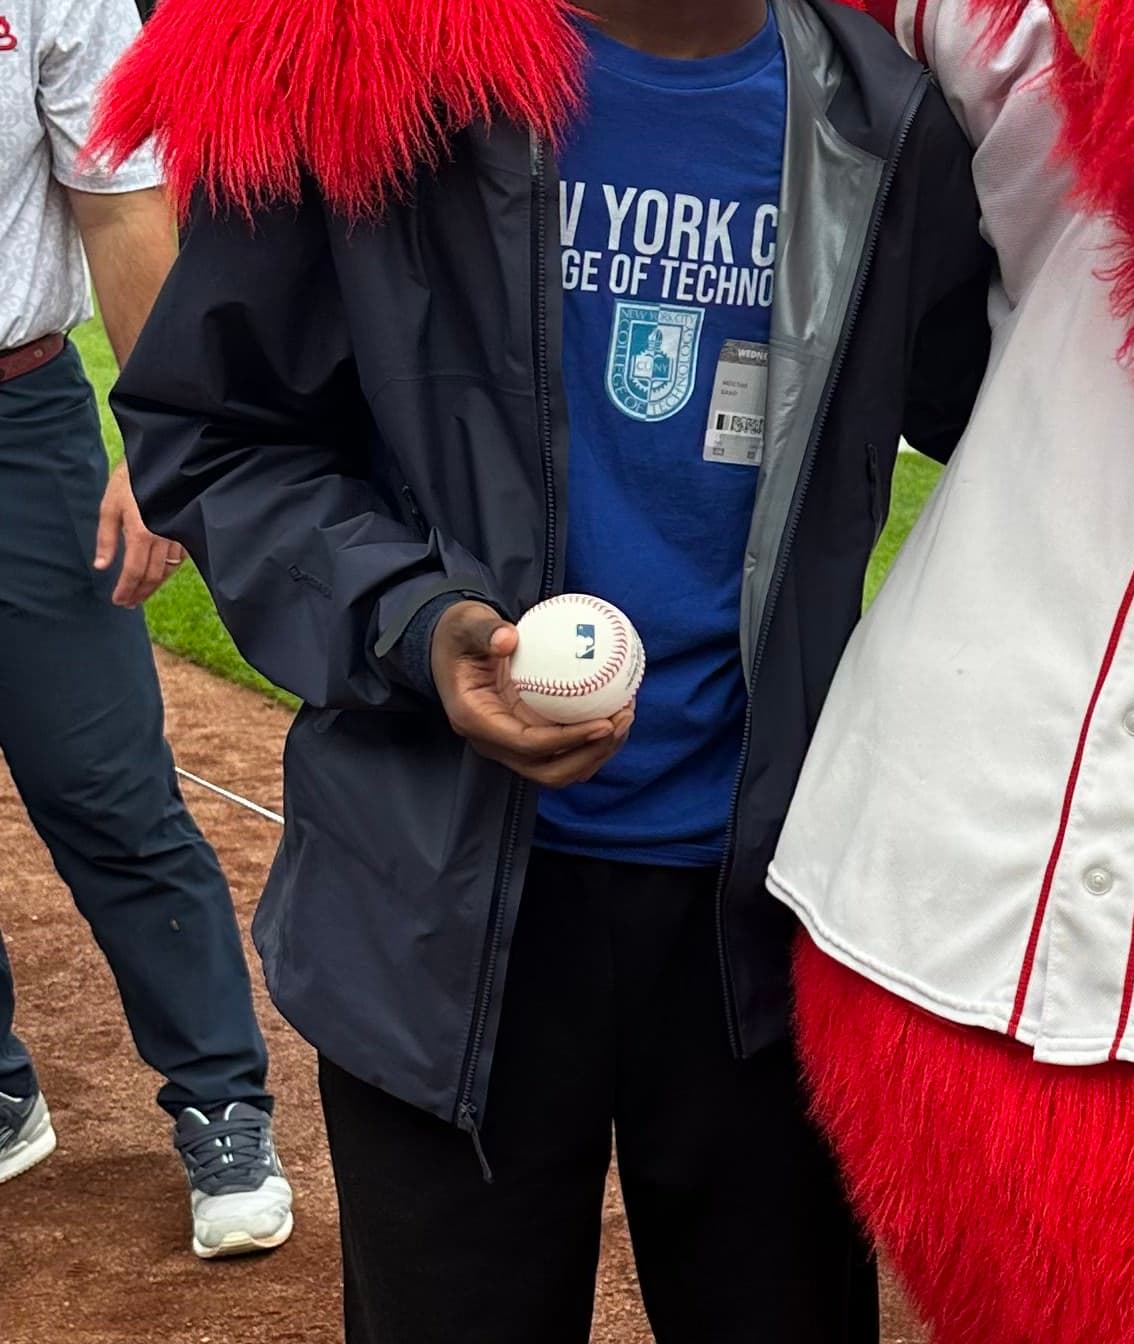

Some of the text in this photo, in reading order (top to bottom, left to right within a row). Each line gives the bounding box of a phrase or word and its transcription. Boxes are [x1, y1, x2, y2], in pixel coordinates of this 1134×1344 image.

[602, 183, 740, 264] YORK
[608, 253, 651, 296] OF
[660, 258, 774, 307] TECHNO
